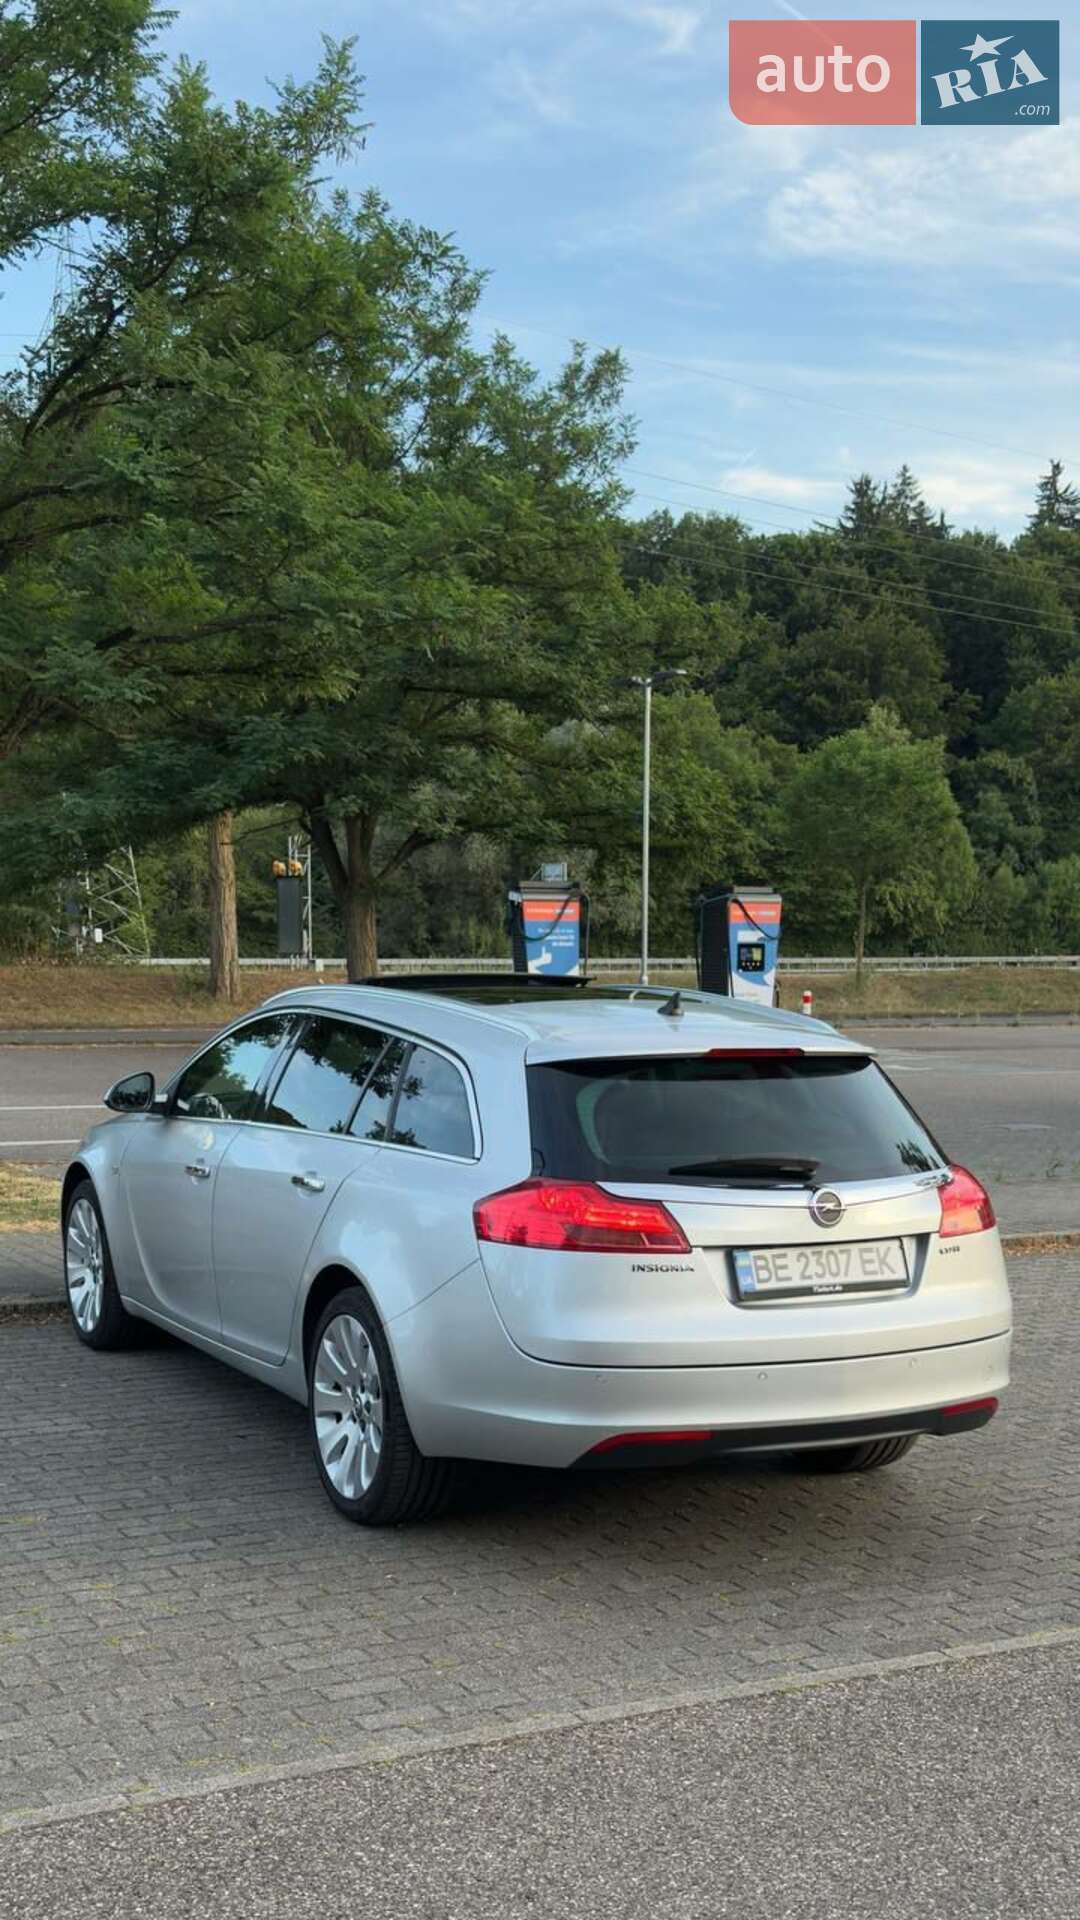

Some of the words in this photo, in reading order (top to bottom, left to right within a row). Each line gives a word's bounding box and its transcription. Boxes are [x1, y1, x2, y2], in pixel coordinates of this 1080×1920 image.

[631, 1263, 695, 1273] INSIGNIA
[753, 1252, 793, 1285] BE
[796, 1248, 852, 1281] 2307
[858, 1246, 896, 1276] EK
